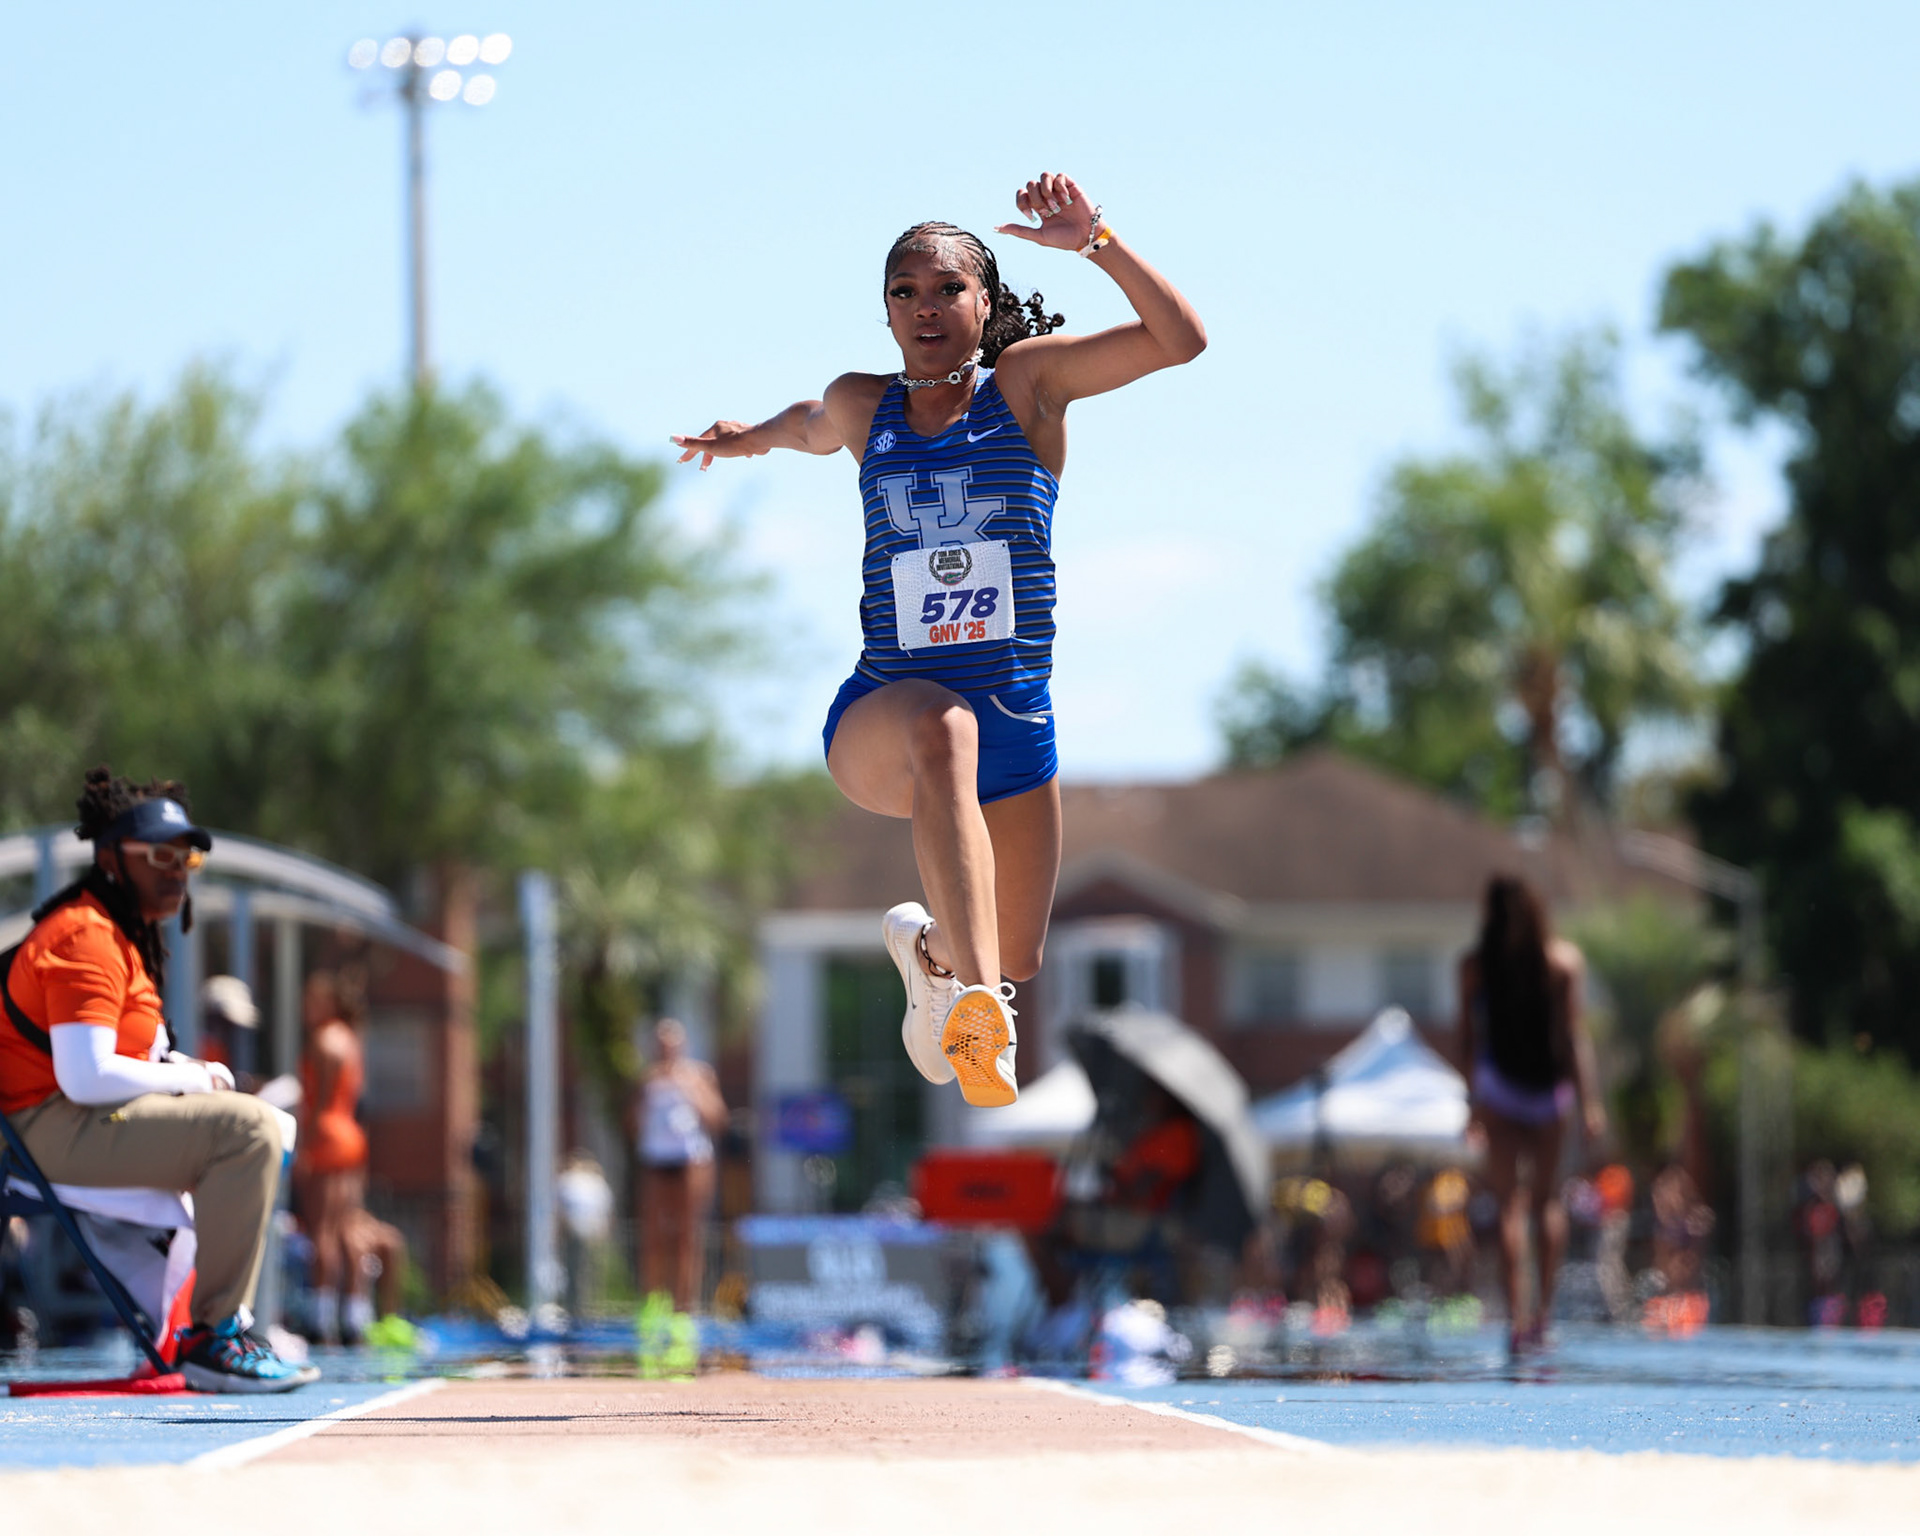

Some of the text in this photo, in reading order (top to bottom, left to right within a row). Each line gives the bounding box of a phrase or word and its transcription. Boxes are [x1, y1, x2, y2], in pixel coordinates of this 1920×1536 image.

[876, 432, 894, 452] SEC
[920, 587, 999, 624] 578
[929, 622, 961, 643] GNV
